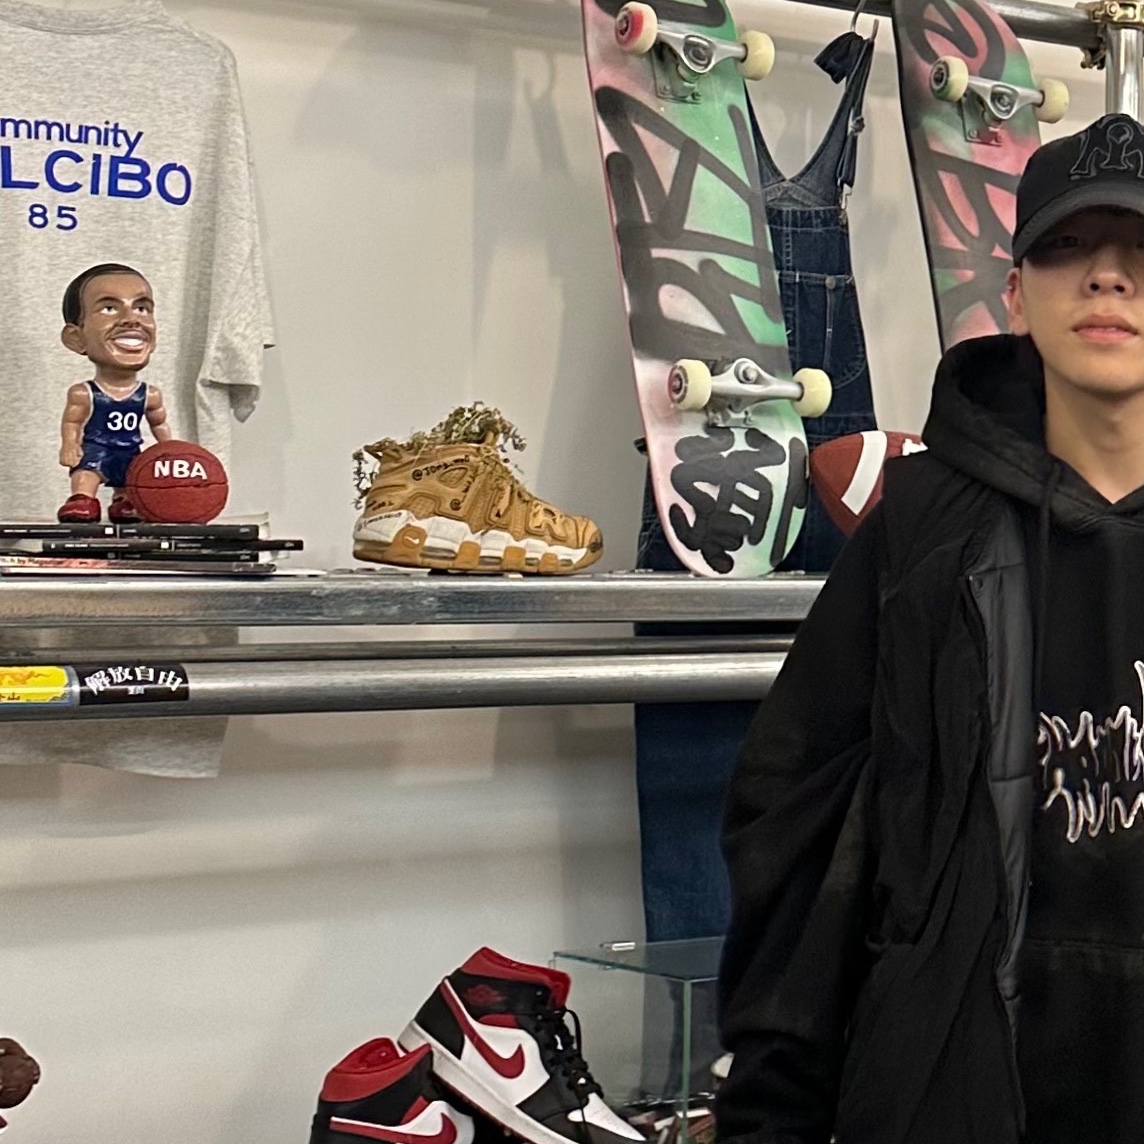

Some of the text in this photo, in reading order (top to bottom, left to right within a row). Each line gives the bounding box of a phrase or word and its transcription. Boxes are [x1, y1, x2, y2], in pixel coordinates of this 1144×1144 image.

[0, 117, 144, 158] mmunity
[1, 145, 192, 206] LCIBO
[28, 203, 78, 231] 85
[106, 411, 138, 431] 30
[154, 459, 208, 480] NBA
[84, 665, 183, 695] 解放自由
